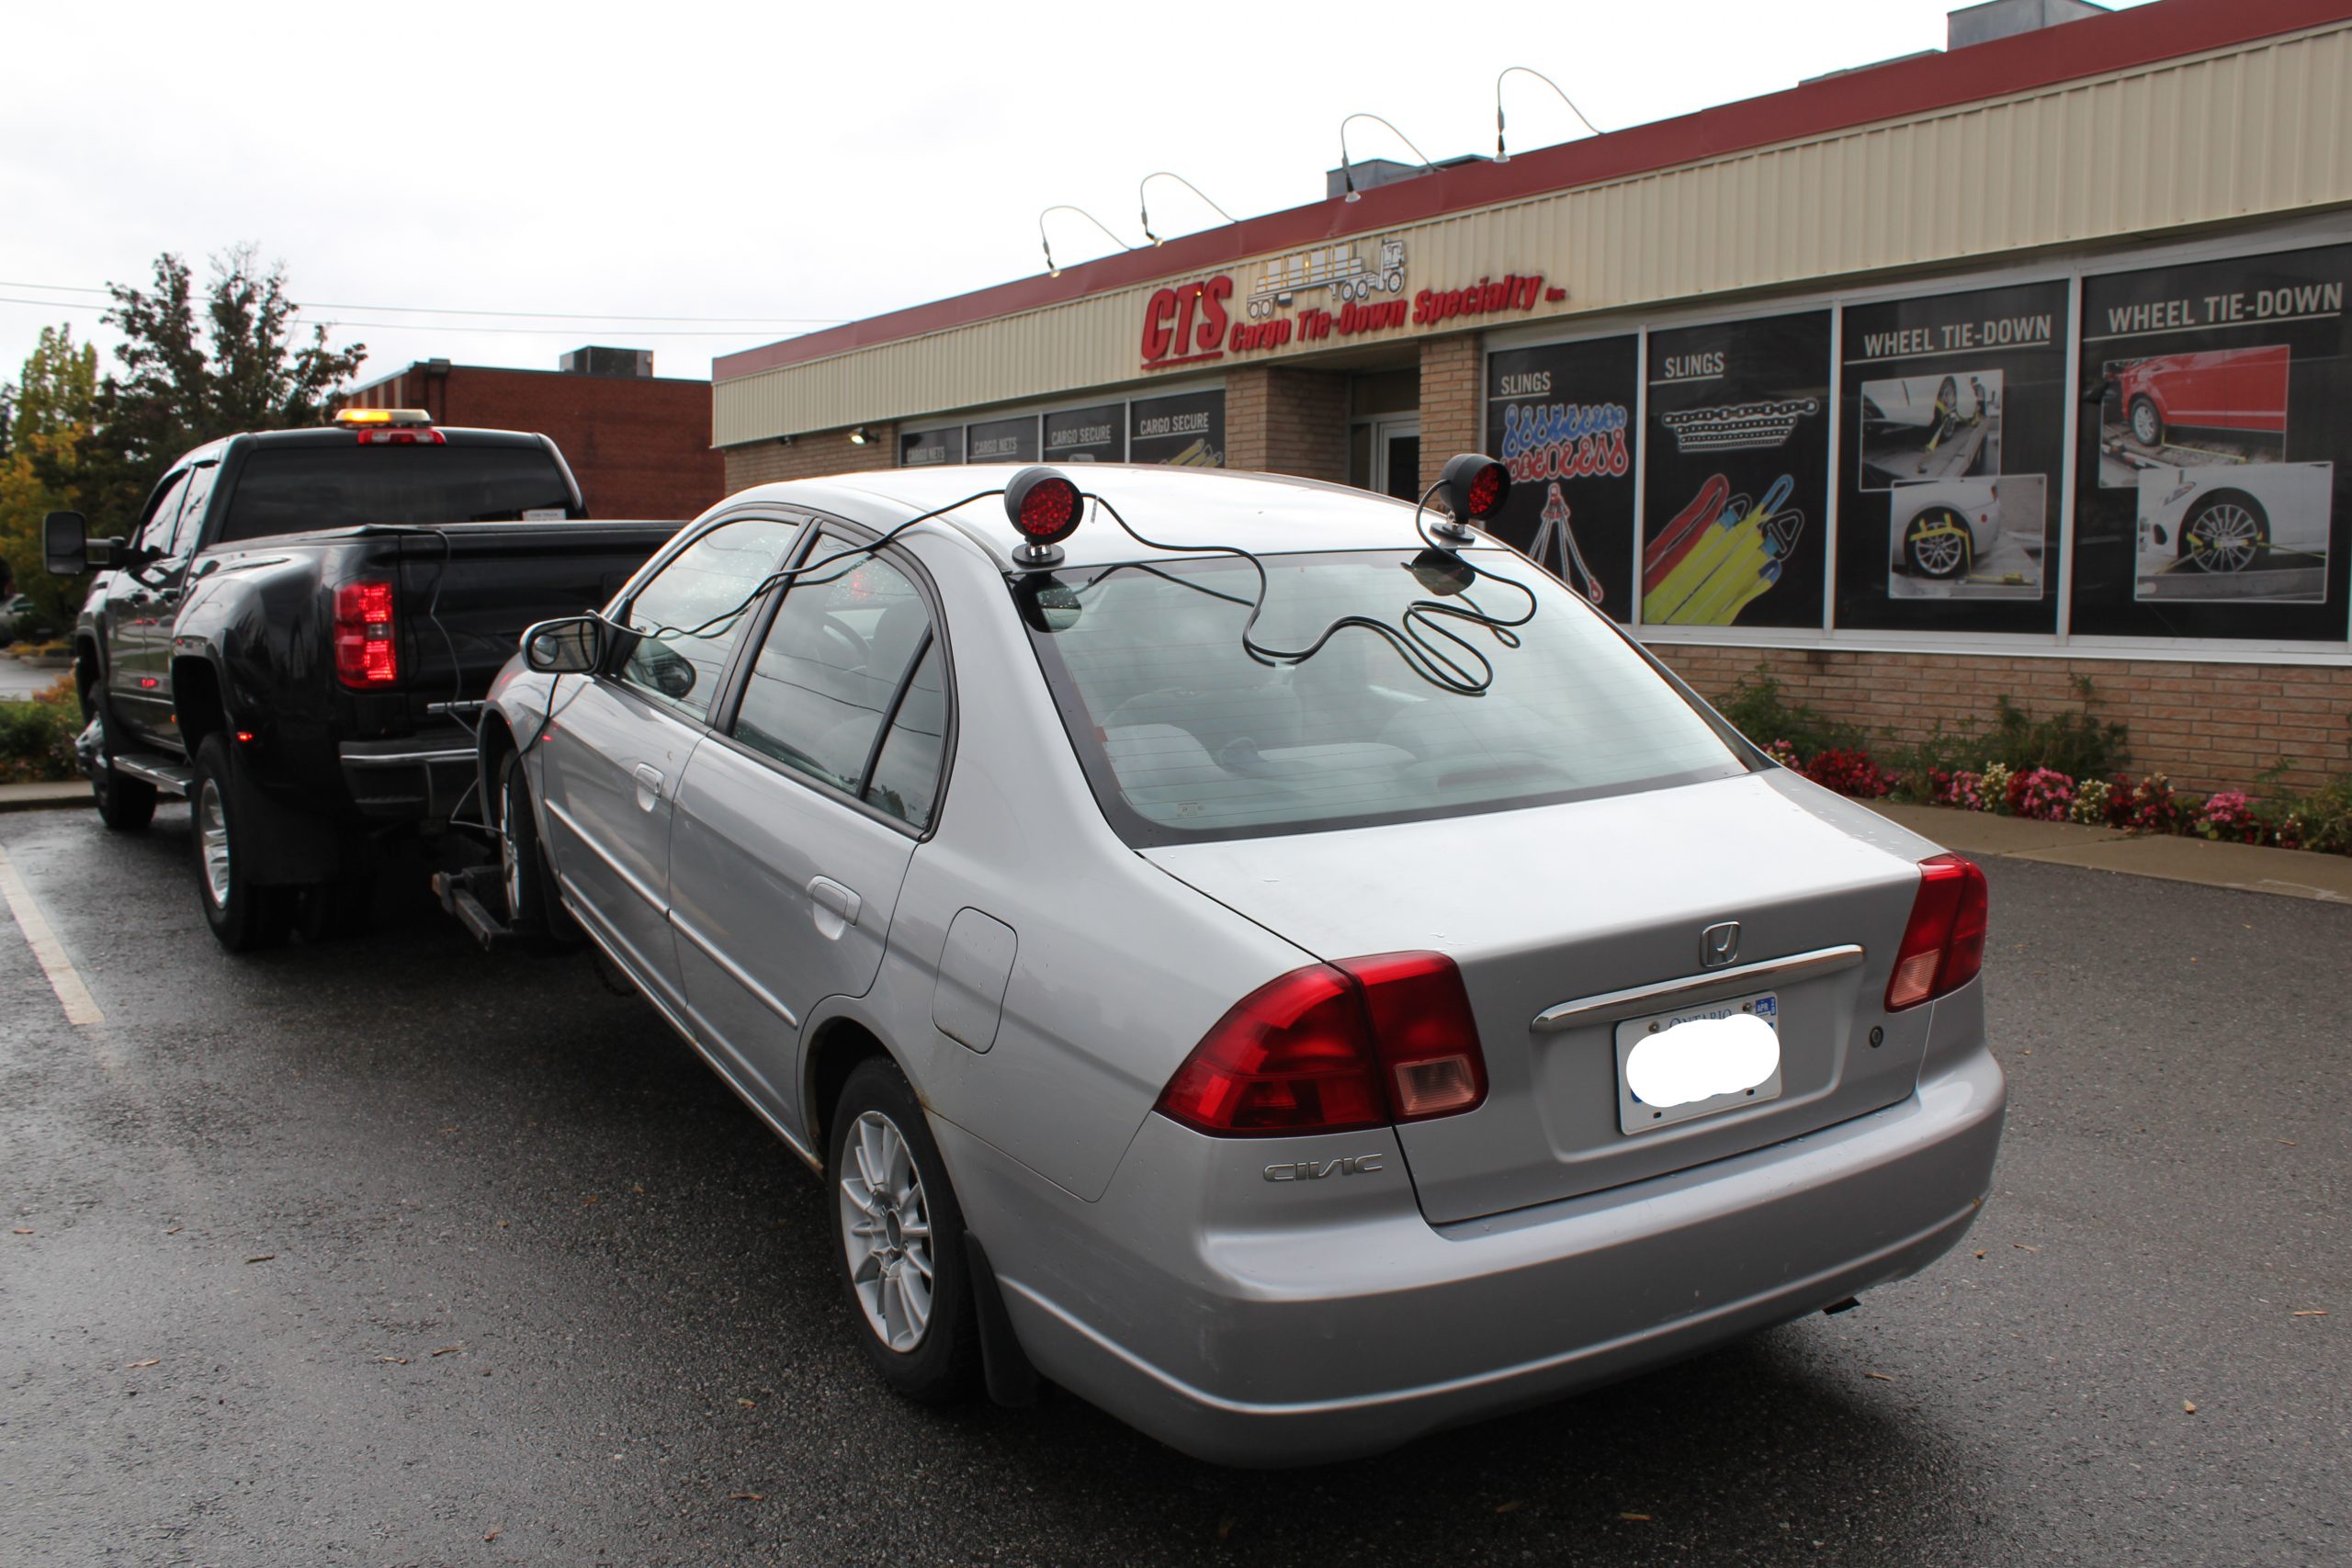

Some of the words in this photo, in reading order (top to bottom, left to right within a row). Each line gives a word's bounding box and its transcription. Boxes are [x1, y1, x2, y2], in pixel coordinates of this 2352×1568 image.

[1142, 275, 1234, 362] CTS
[1228, 318, 1292, 353] Cargo
[1296, 299, 1408, 343] Tie-Down
[1413, 274, 1544, 325] Specialty
[2109, 299, 2196, 333] WHEEL
[2203, 281, 2343, 322] TIE-DOWN
[1863, 327, 1935, 358] WHEEL
[1941, 313, 2052, 350] TIE-DOWN
[1664, 351, 1725, 379] SLINGS
[1500, 371, 1552, 396] SLINGS
[1051, 428, 1078, 446] CARGO
[1079, 424, 1112, 442] SECURE
[1139, 416, 1170, 435] CARGO
[1171, 412, 1209, 433] SECURE
[1263, 1153, 1383, 1183] CIVIC
